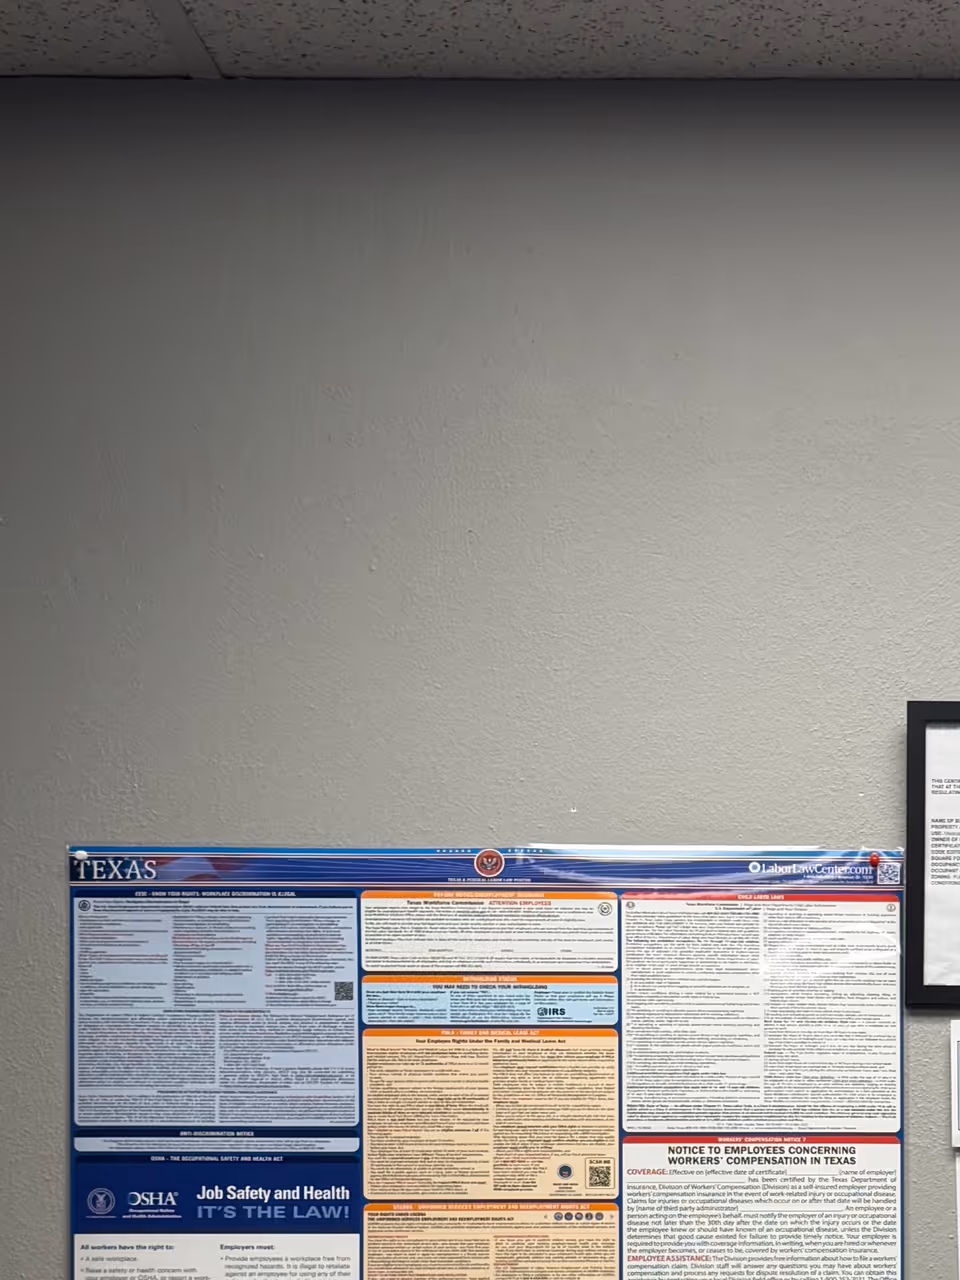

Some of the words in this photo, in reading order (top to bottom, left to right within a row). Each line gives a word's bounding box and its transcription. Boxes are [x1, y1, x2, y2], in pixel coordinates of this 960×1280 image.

[74, 859, 159, 880] TEXAS
[762, 863, 873, 875] LaborLawCenter.com
[548, 1007, 566, 1017] IRS
[668, 1146, 705, 1154] NOTICE
[707, 1146, 721, 1154] TO
[724, 1146, 785, 1154] EMPLOYEES
[788, 1146, 856, 1154] CONCERNING
[667, 1156, 723, 1165] WORKERS'
[726, 1156, 807, 1165] COMPENSATION
[810, 1156, 820, 1165] IN
[823, 1156, 856, 1165] TEXAS
[196, 1185, 223, 1199] Job
[226, 1185, 271, 1203] Safety
[273, 1185, 300, 1200] and
[303, 1185, 349, 1200] Health
[197, 1205, 236, 1218] IT'S
[242, 1205, 286, 1218] THE
[293, 1205, 349, 1218] LAW!
